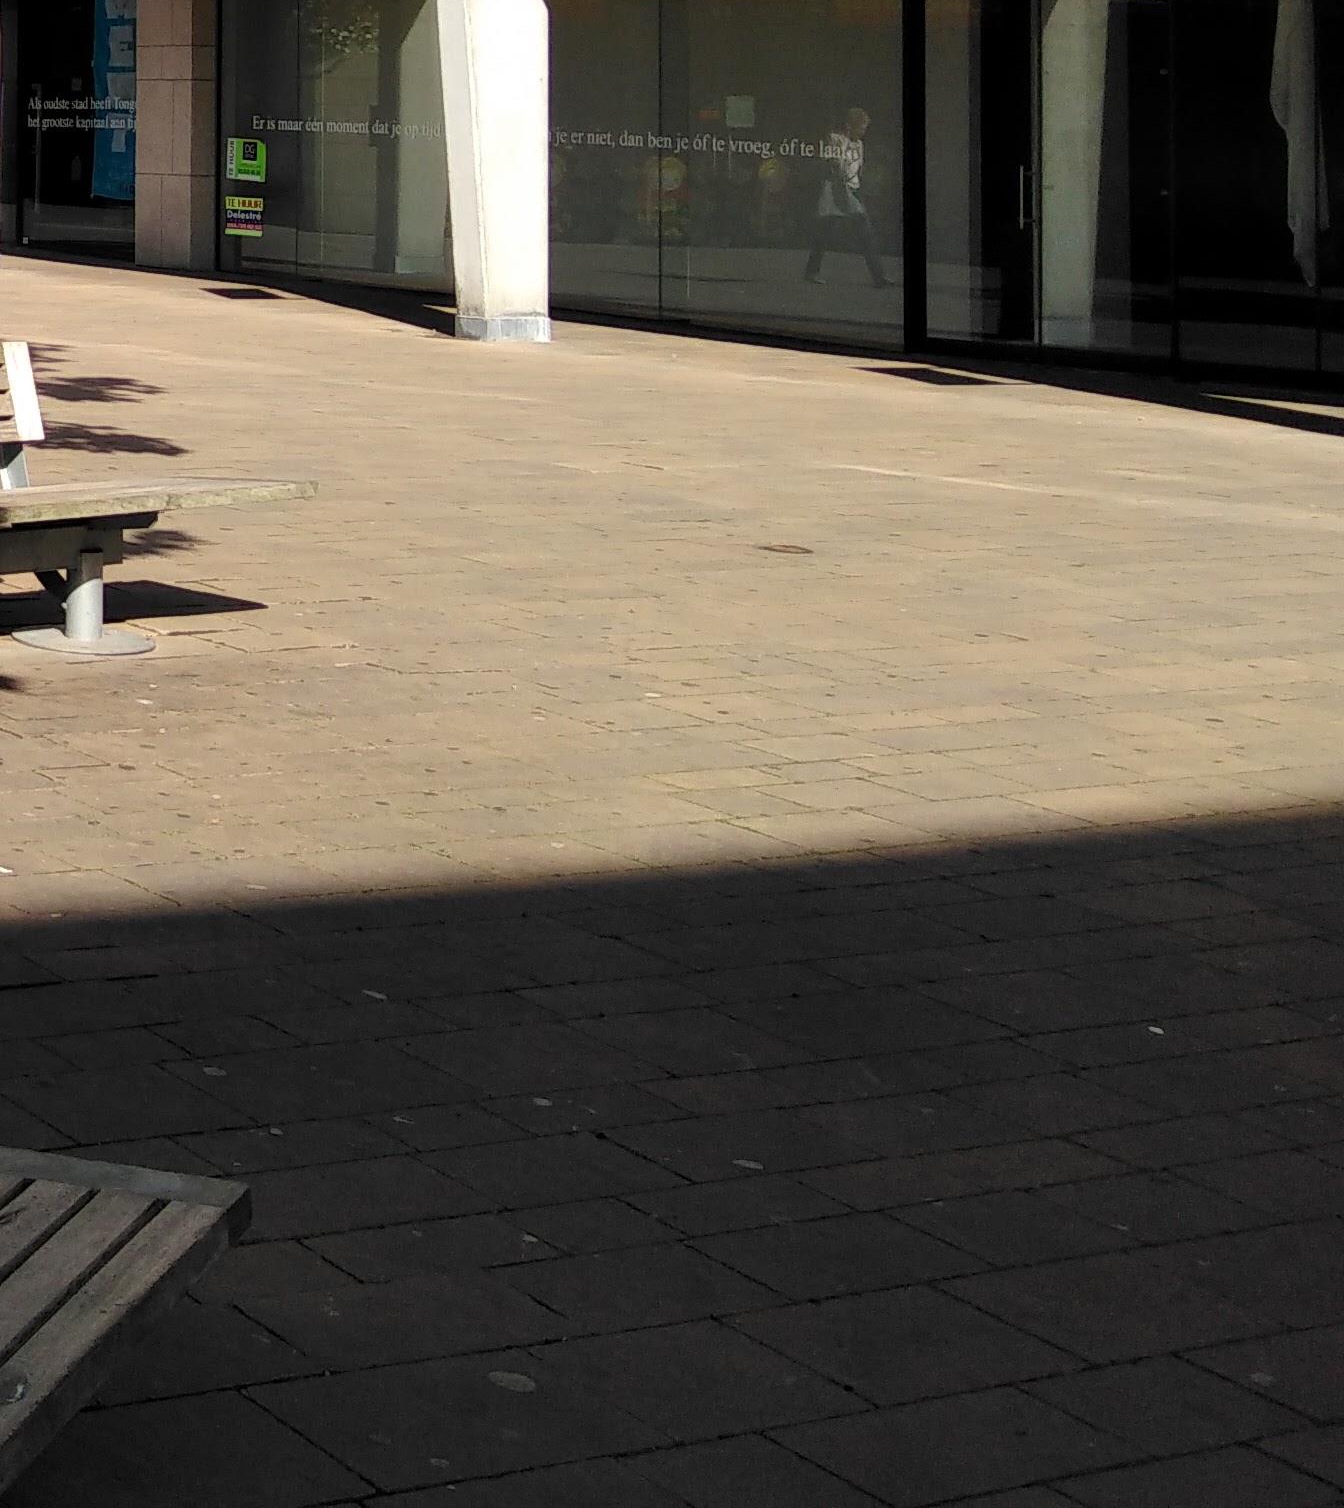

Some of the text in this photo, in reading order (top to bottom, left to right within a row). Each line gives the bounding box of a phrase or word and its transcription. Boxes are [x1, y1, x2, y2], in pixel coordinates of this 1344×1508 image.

[27, 97, 42, 110] Als
[43, 96, 70, 110] oudste
[71, 96, 89, 110] stad
[27, 114, 41, 128] het
[41, 116, 74, 131] grootste
[252, 115, 265, 130] Er
[266, 115, 276, 130] is
[277, 120, 304, 132] maar
[305, 116, 324, 132] één
[326, 120, 370, 134] moment
[372, 119, 389, 135] dat
[390, 120, 402, 138] je
[404, 125, 419, 139] op
[554, 127, 568, 147] je
[570, 131, 585, 144] er
[586, 128, 616, 148] niet,
[619, 129, 644, 148] dan
[647, 131, 673, 150] ben
[674, 133, 689, 154] je
[693, 132, 712, 151] óf
[712, 135, 725, 152] te
[728, 139, 775, 159] vroeg,
[780, 136, 799, 156] óf
[800, 142, 814, 158] te
[227, 198, 236, 207] TE
